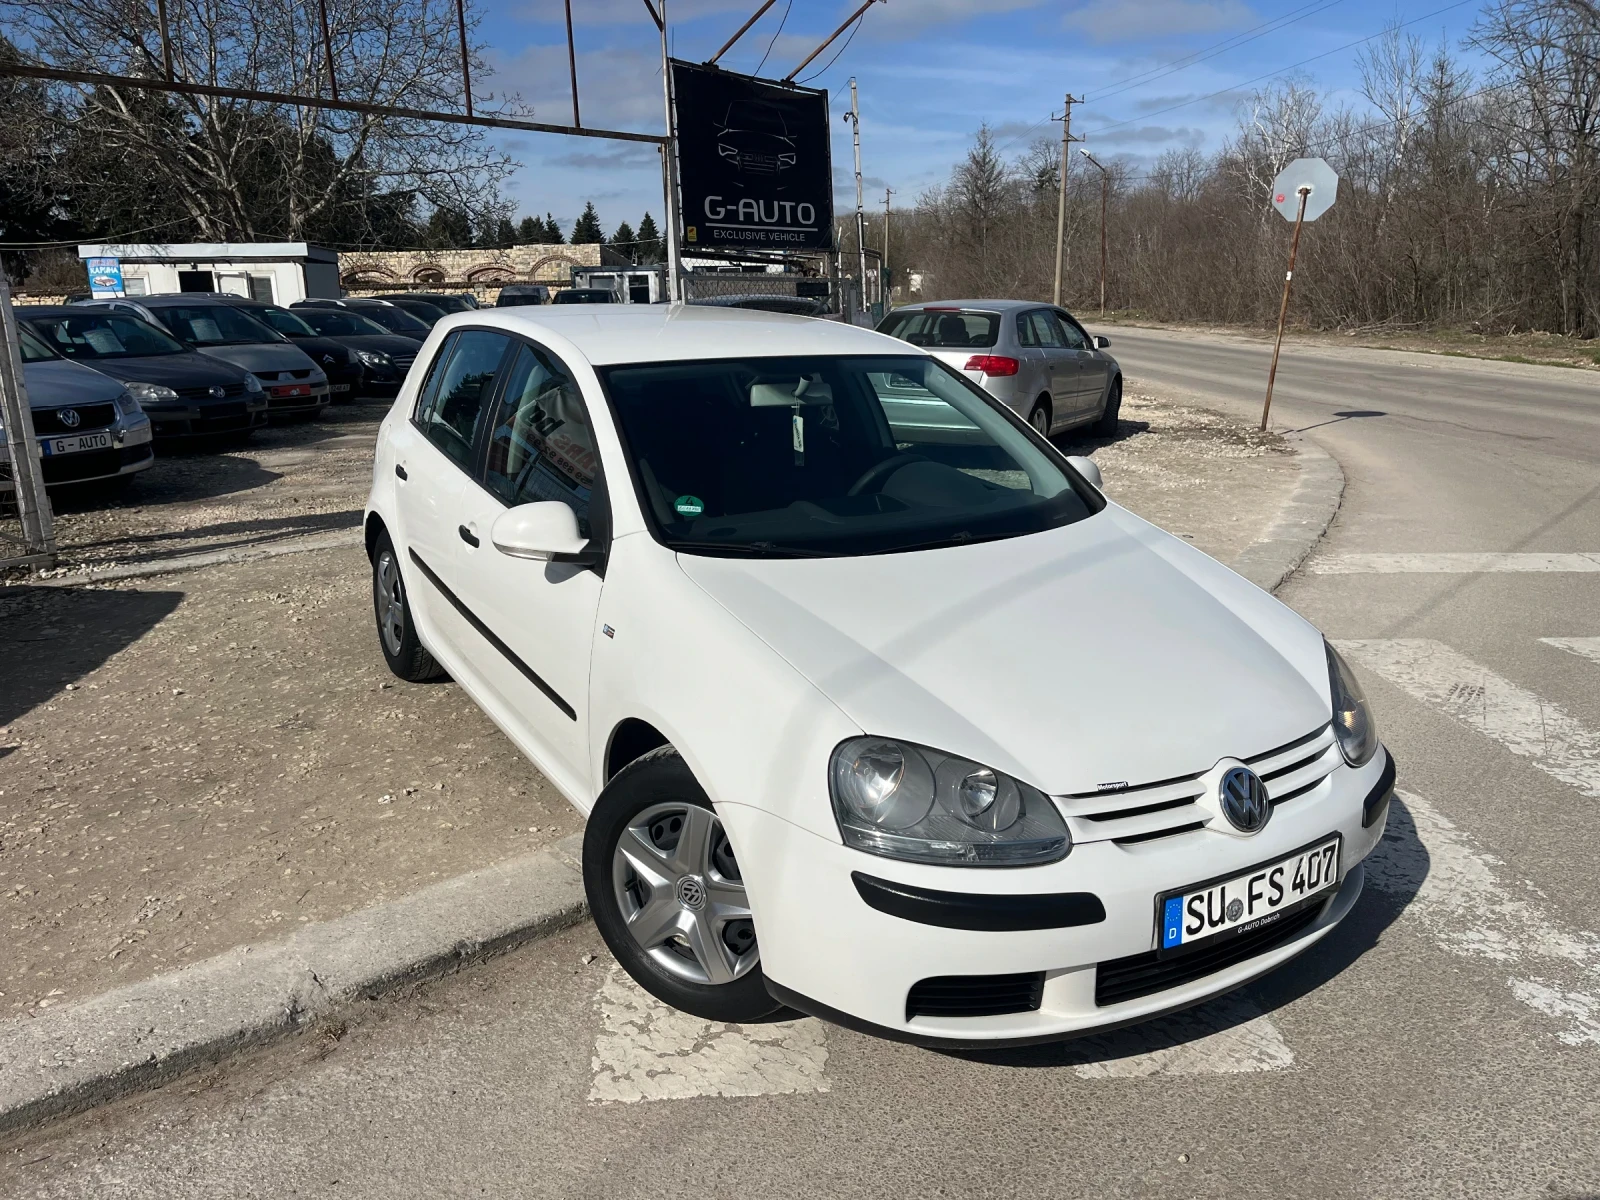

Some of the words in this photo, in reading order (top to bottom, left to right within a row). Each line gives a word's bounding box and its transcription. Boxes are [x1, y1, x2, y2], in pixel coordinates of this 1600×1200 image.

[704, 195, 816, 225] G-AUTO
[713, 229, 767, 241] EXCLUSIVE
[768, 232, 806, 242] VEHICLE
[1185, 886, 1226, 935] SU
[1248, 866, 1284, 915] FS
[1291, 843, 1337, 895] 407
[1168, 927, 1177, 940] D
[1237, 920, 1260, 934] G-AUTO
[1260, 912, 1281, 926] Dobrich
